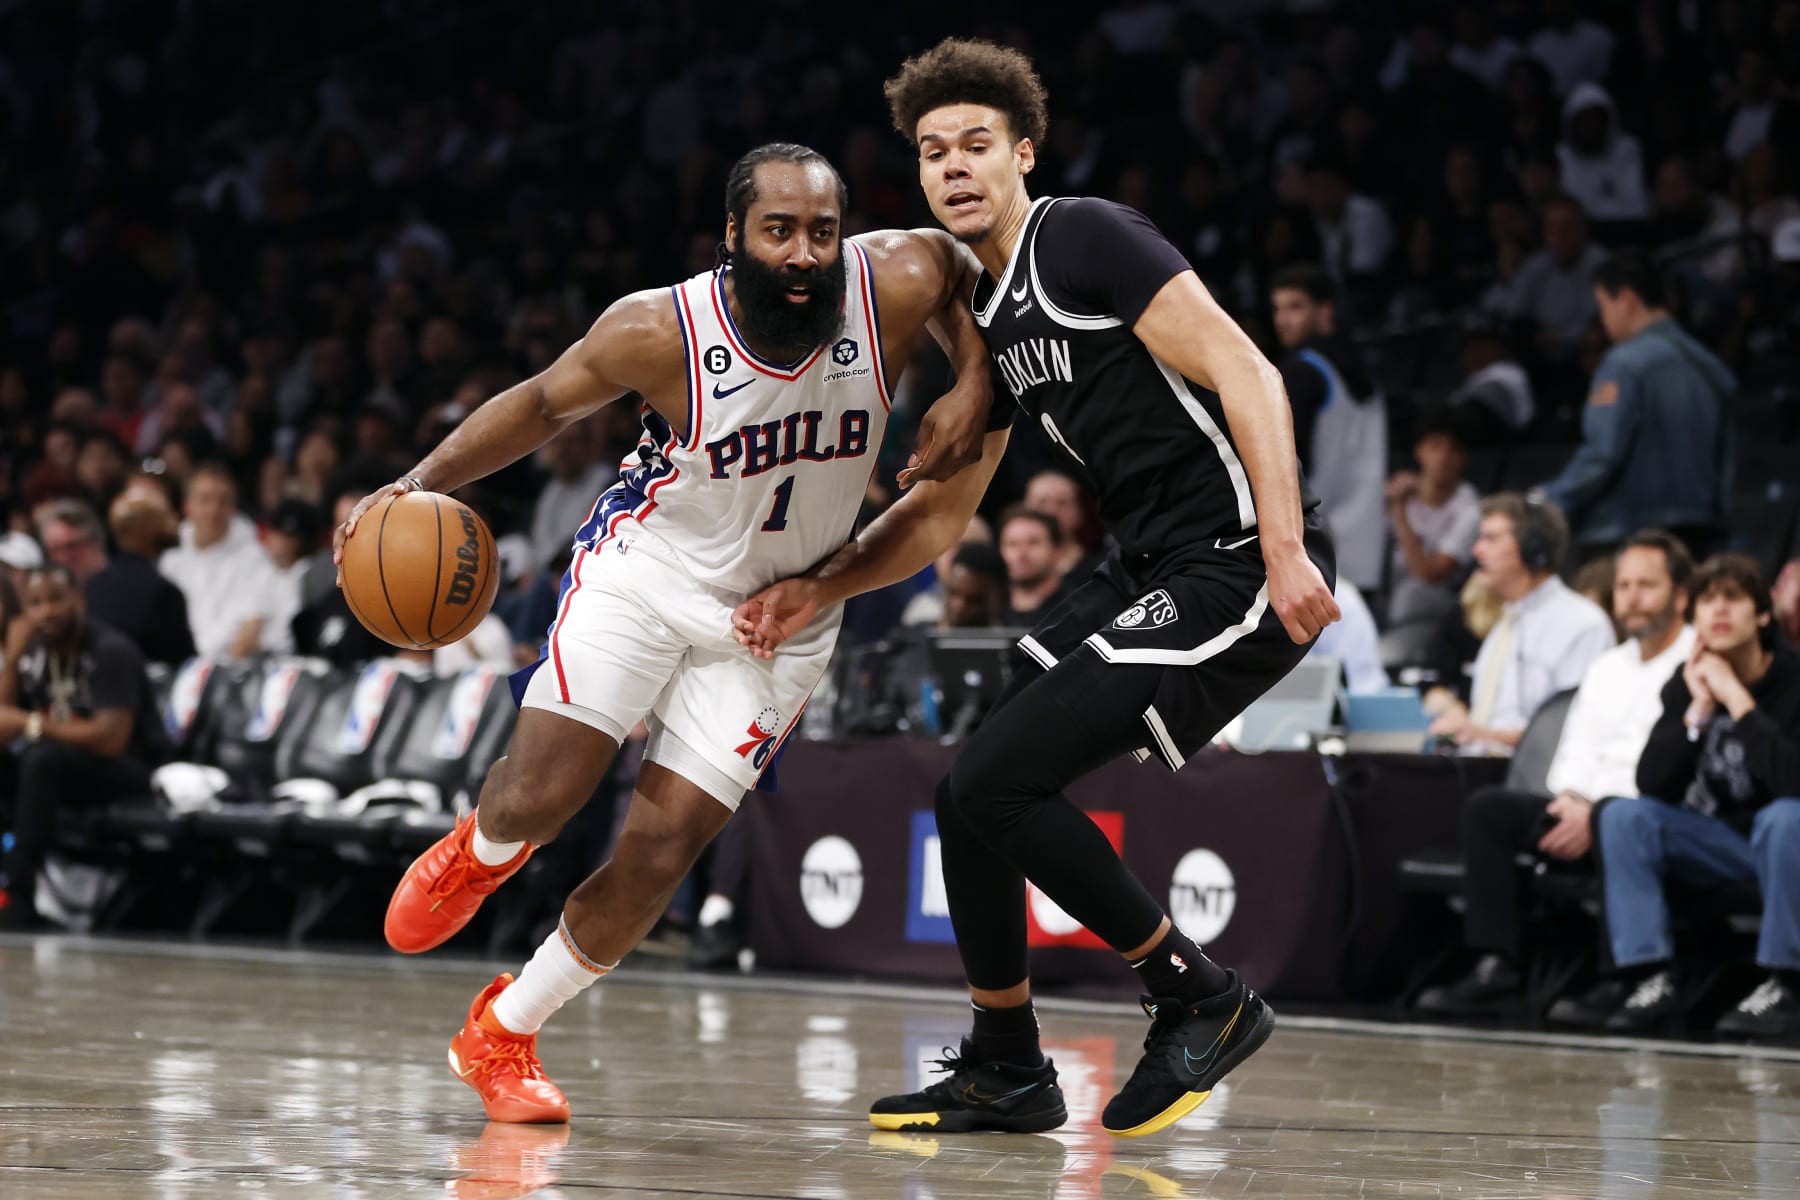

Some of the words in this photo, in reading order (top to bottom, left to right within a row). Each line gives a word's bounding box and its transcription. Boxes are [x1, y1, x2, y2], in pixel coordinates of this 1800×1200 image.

[710, 350, 726, 371] 6
[823, 367, 870, 382] crypto.com
[997, 337, 1073, 396] OKLYN
[705, 409, 870, 480] PHILA
[760, 475, 795, 532] 1
[444, 508, 480, 606] Wilson
[733, 719, 777, 770] 76
[801, 868, 862, 899] TNT
[1170, 884, 1234, 916] TNT
